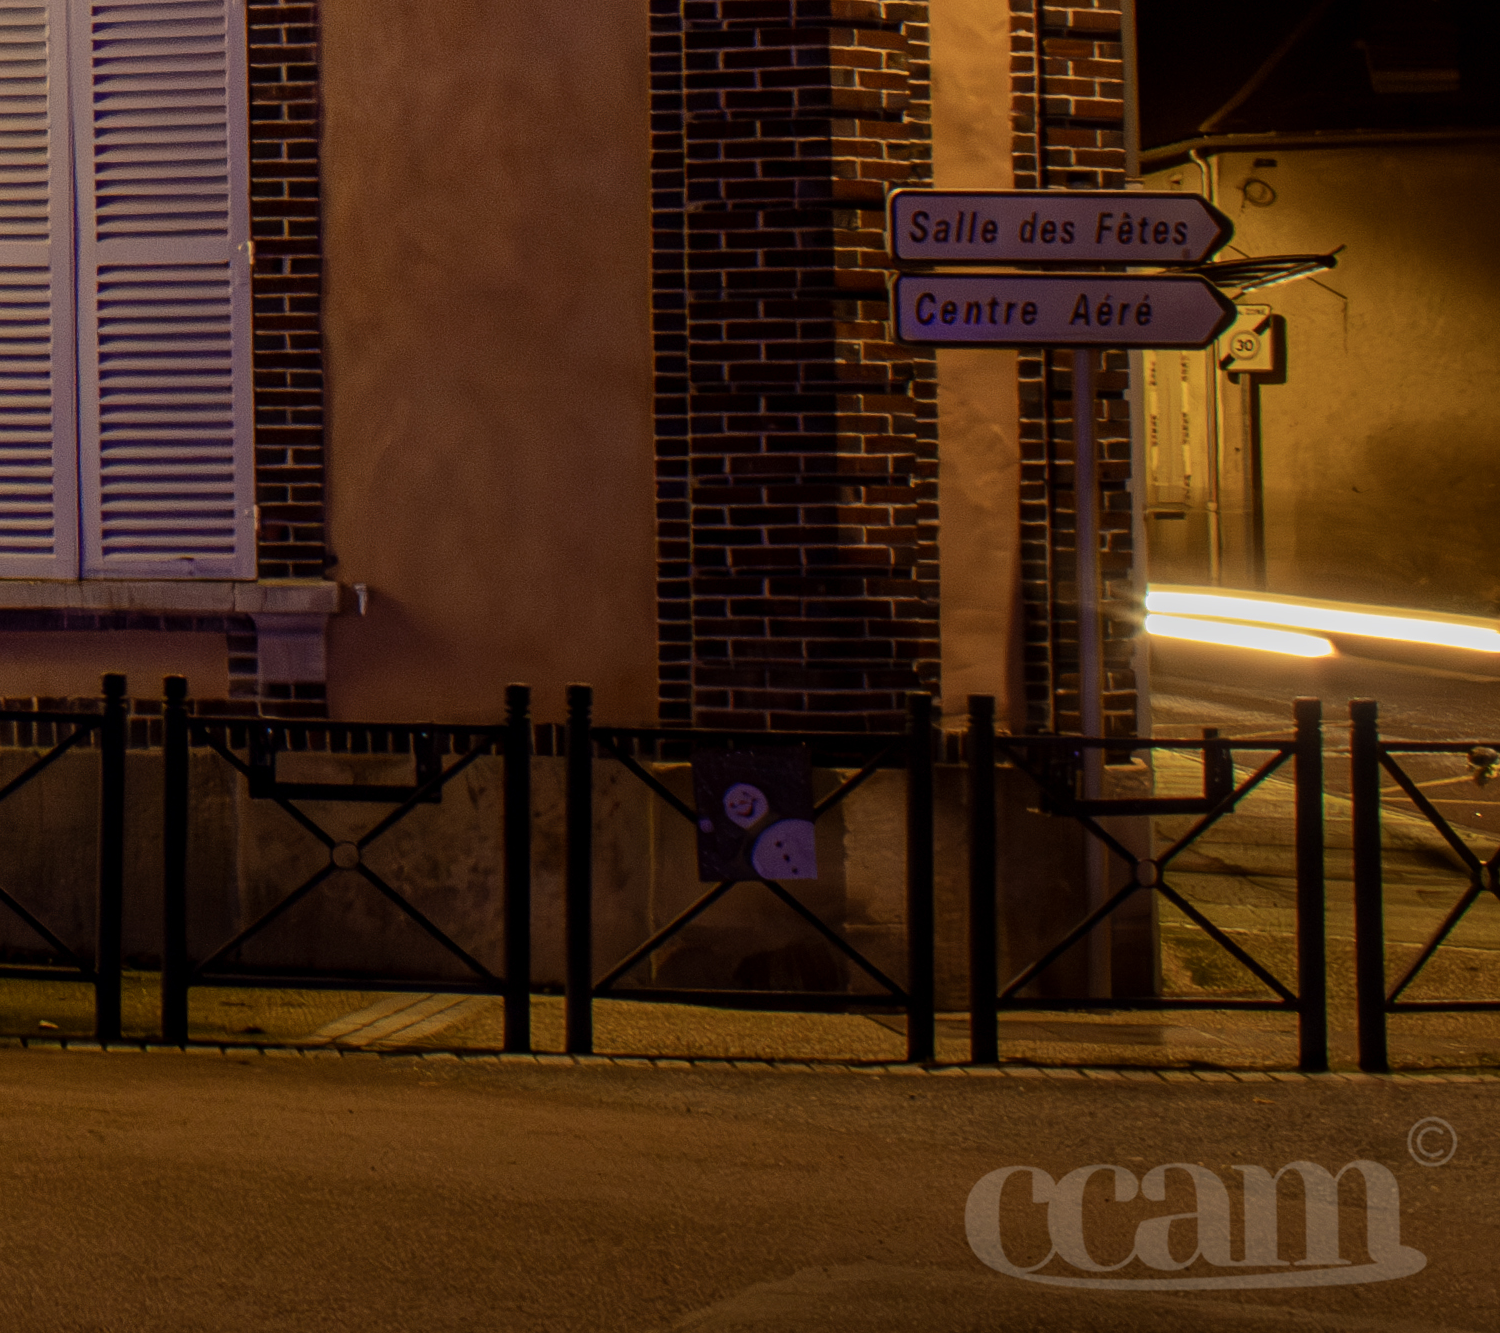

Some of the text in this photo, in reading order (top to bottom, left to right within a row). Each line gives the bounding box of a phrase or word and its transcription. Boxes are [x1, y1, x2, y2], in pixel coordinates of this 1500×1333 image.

[909, 210, 1189, 245] Salle des Fêtes
[914, 291, 1154, 327] Centre Aéré
[1235, 339, 1254, 352] 30
